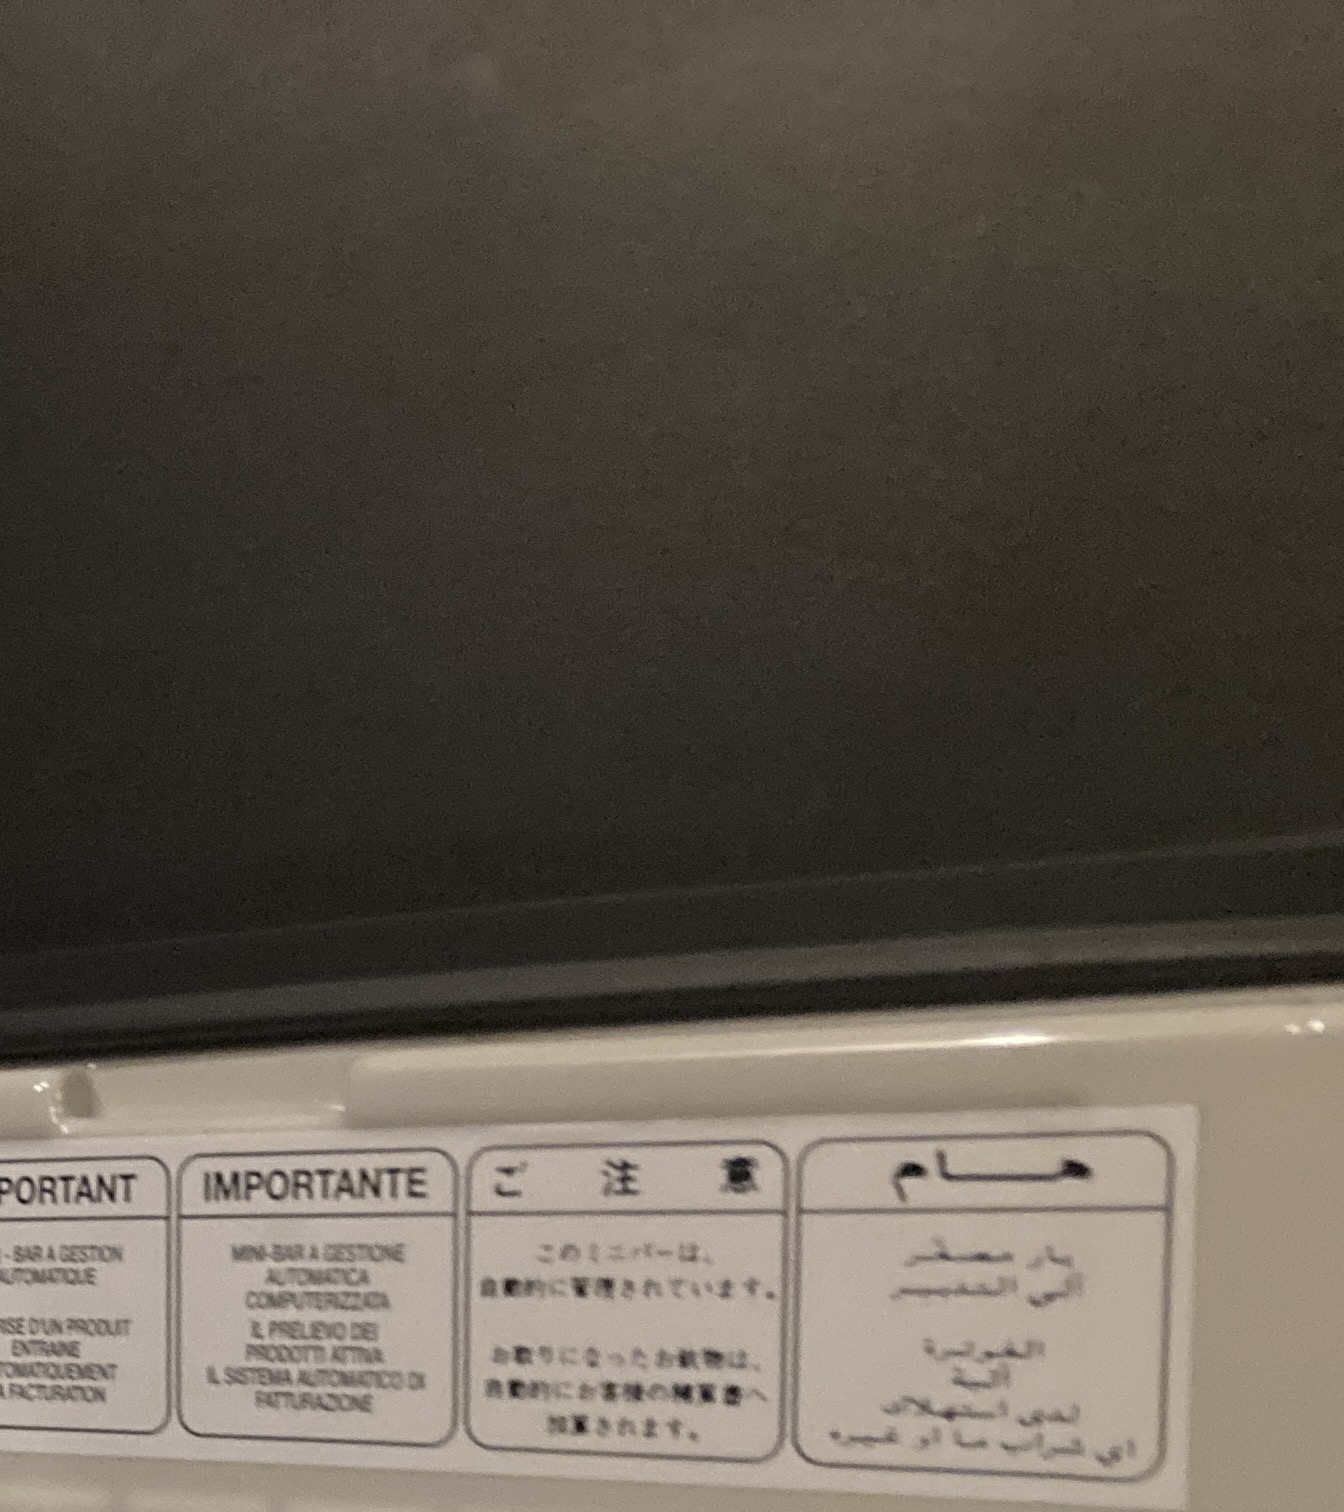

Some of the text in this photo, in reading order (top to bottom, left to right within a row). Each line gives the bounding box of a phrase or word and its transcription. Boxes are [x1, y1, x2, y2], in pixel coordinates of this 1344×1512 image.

[203, 1166, 430, 1202] IMPORTANTE
[493, 1155, 760, 1198] ご注意
